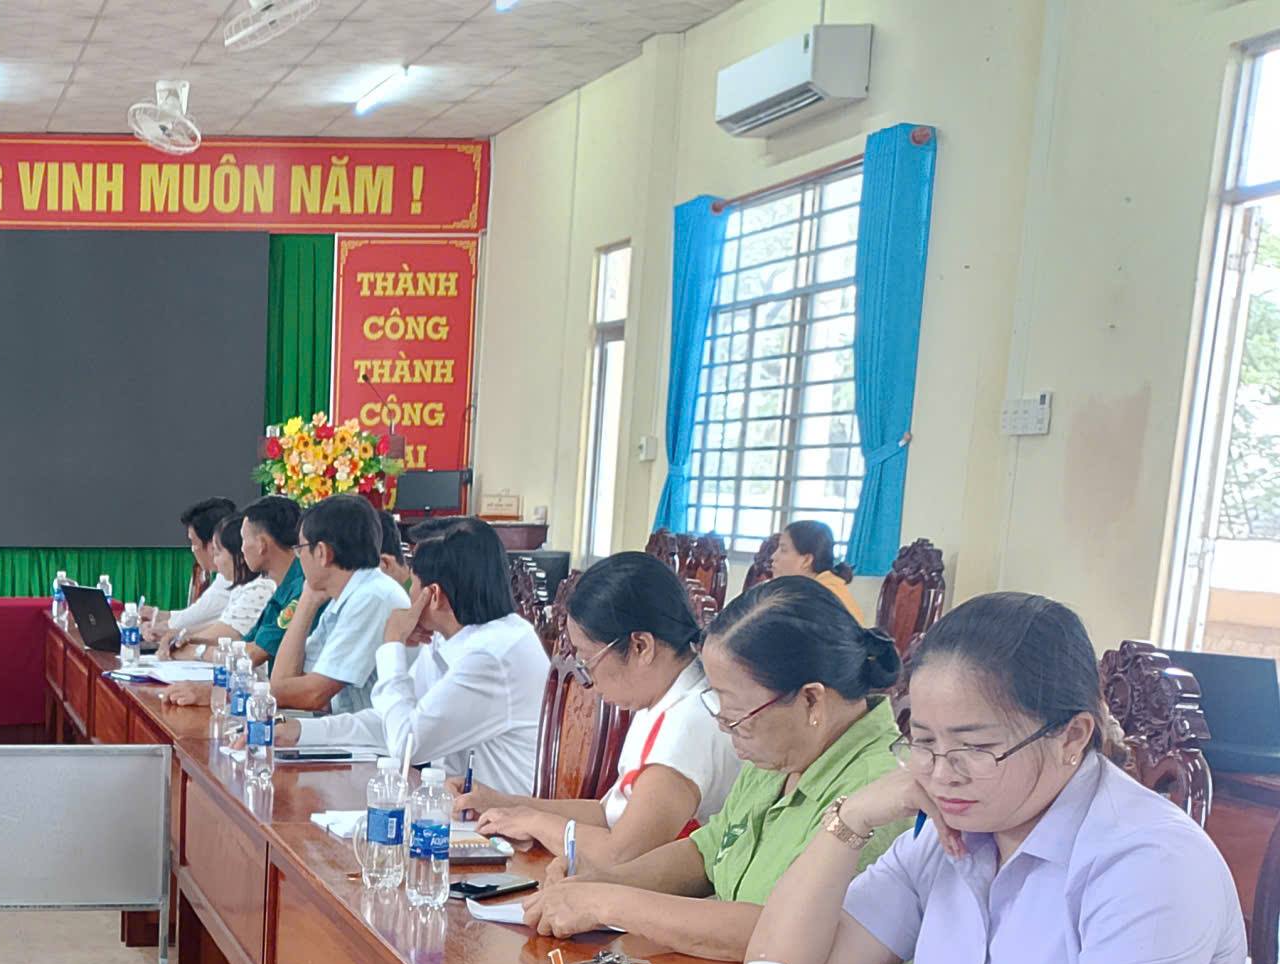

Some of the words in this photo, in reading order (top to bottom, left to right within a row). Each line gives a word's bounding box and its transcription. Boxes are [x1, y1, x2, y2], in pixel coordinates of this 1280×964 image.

[18, 160, 125, 213] VINH
[139, 153, 275, 214] MUÔN
[289, 156, 394, 215] NĂM
[410, 166, 424, 215] !
[356, 263, 459, 297] THÀNH
[363, 308, 449, 341] CÔNG
[353, 351, 455, 384] THÀNH
[359, 394, 446, 427] CÔNG
